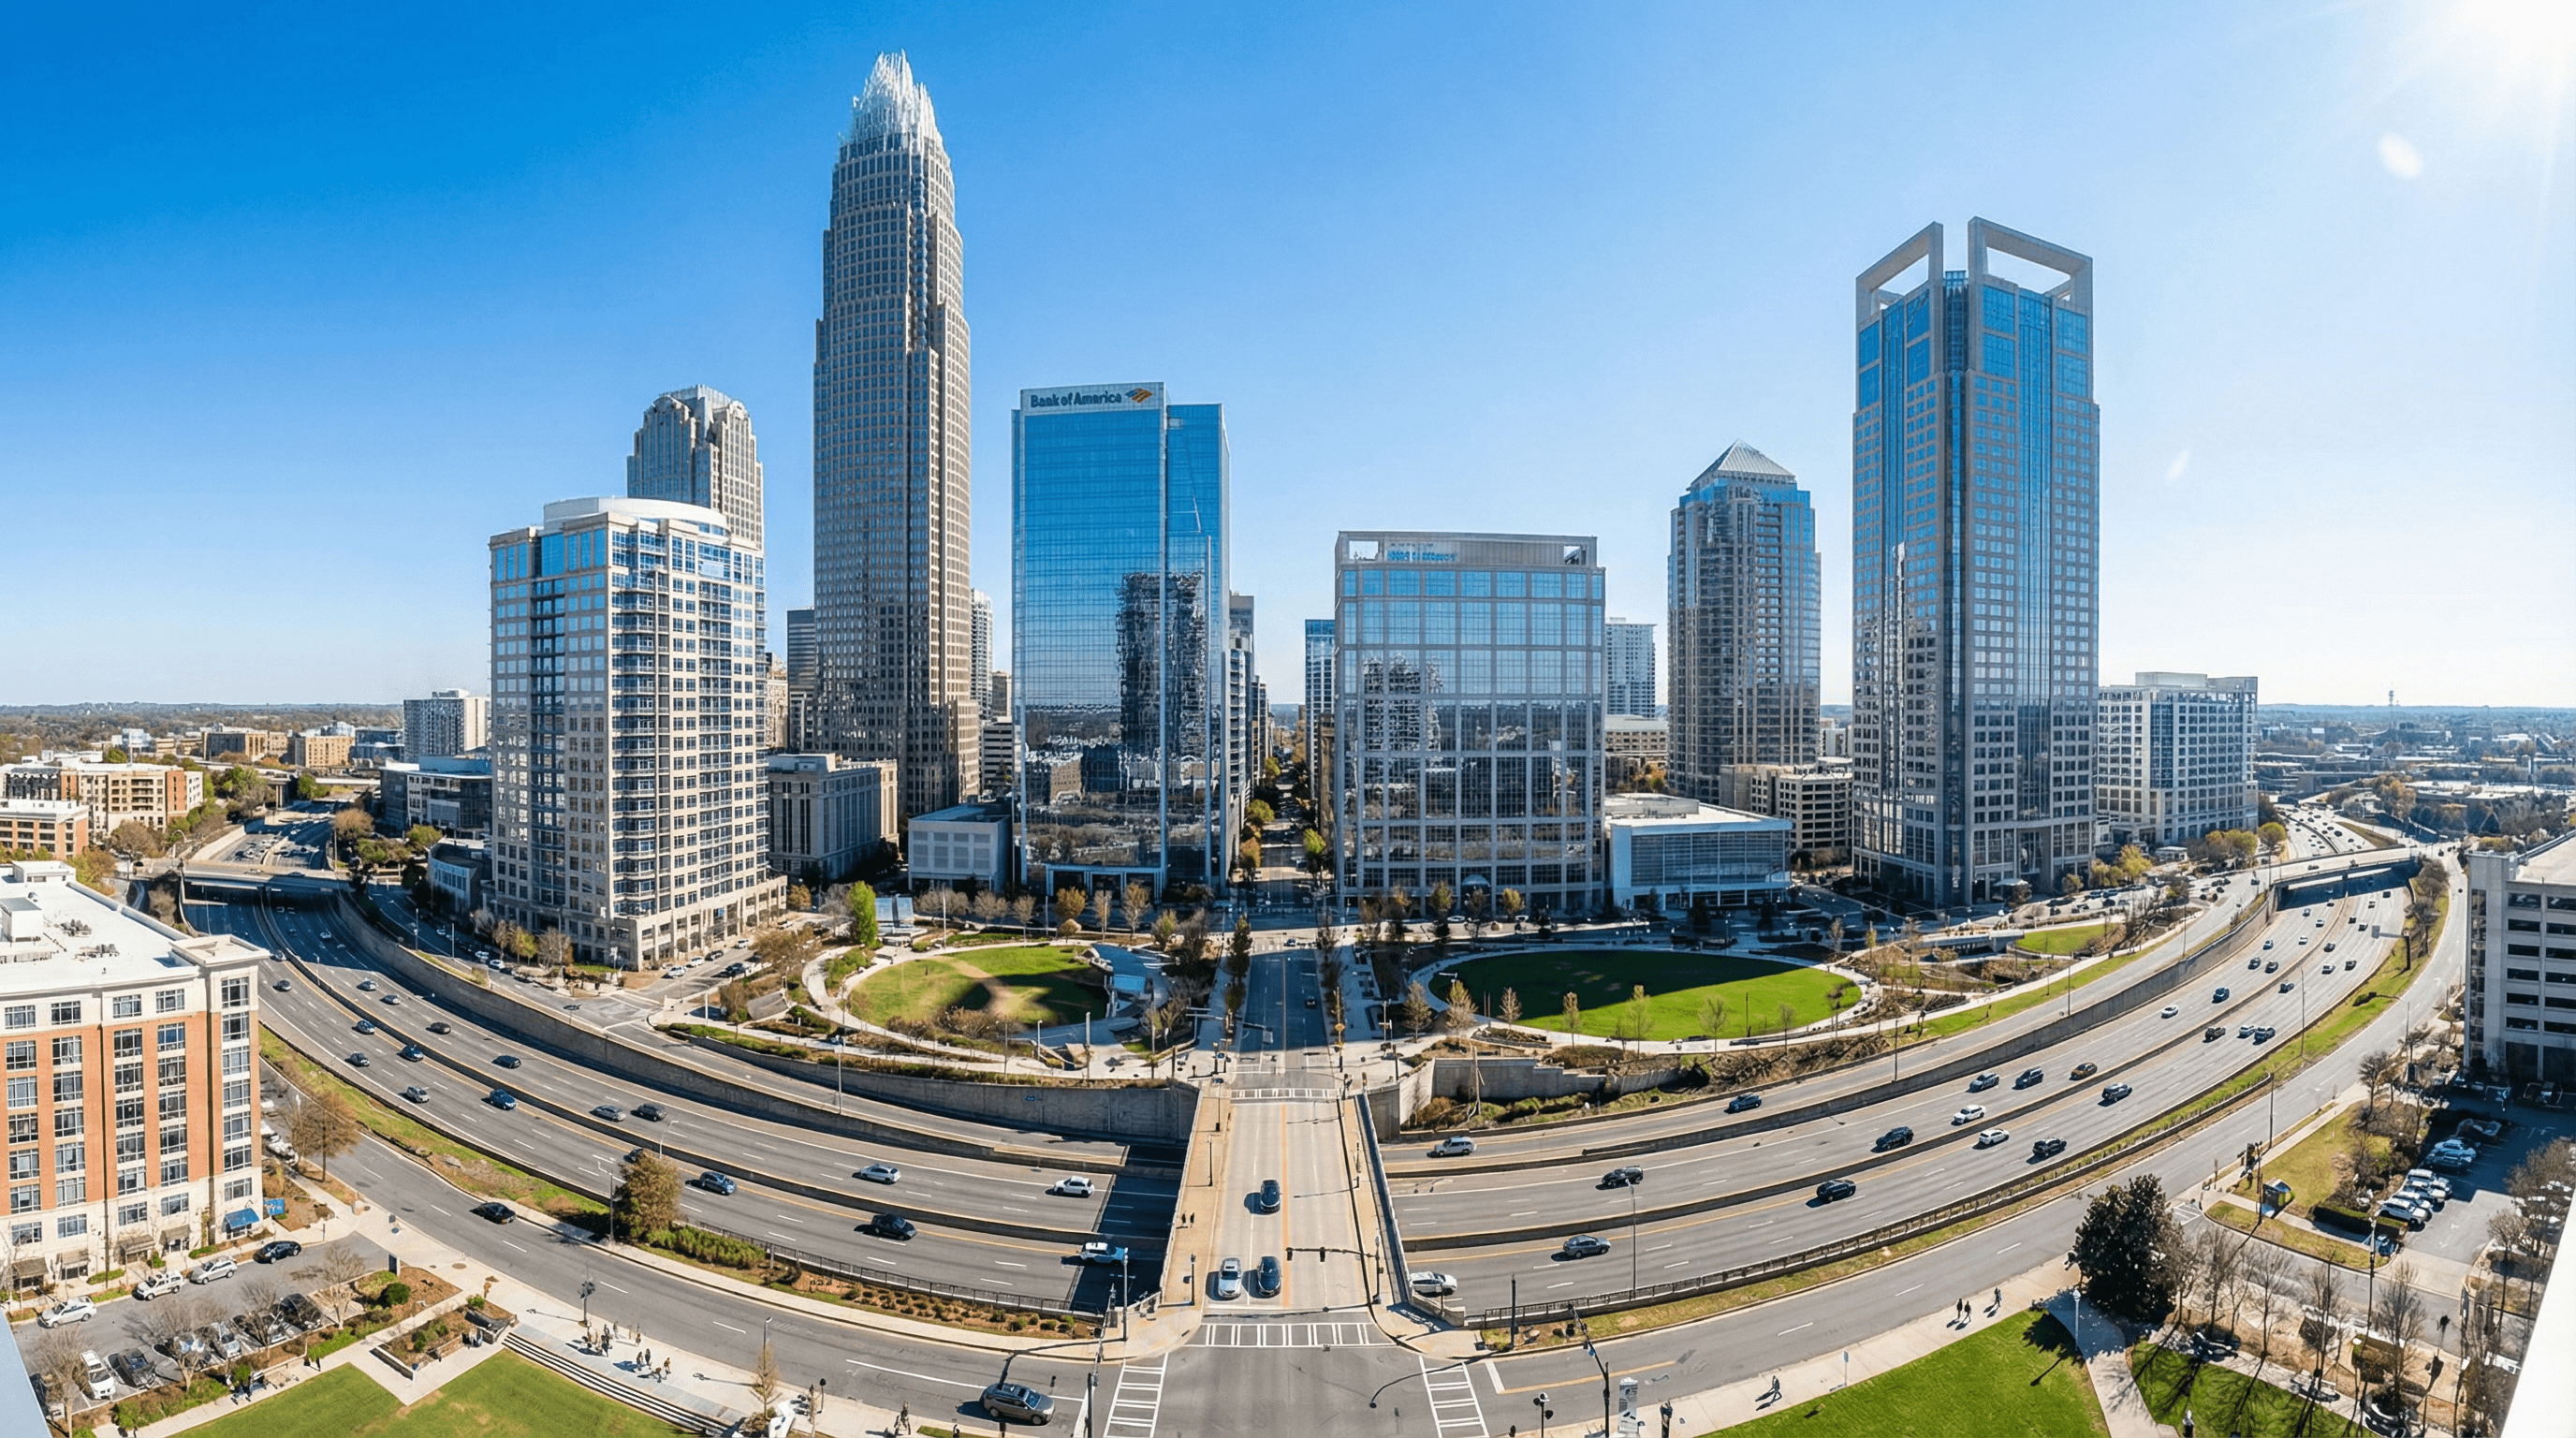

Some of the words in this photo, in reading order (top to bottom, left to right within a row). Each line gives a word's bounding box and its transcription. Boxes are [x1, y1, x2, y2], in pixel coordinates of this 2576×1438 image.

[1031, 393, 1060, 407] Bank
[1061, 392, 1073, 405] of
[1074, 389, 1122, 404] America
